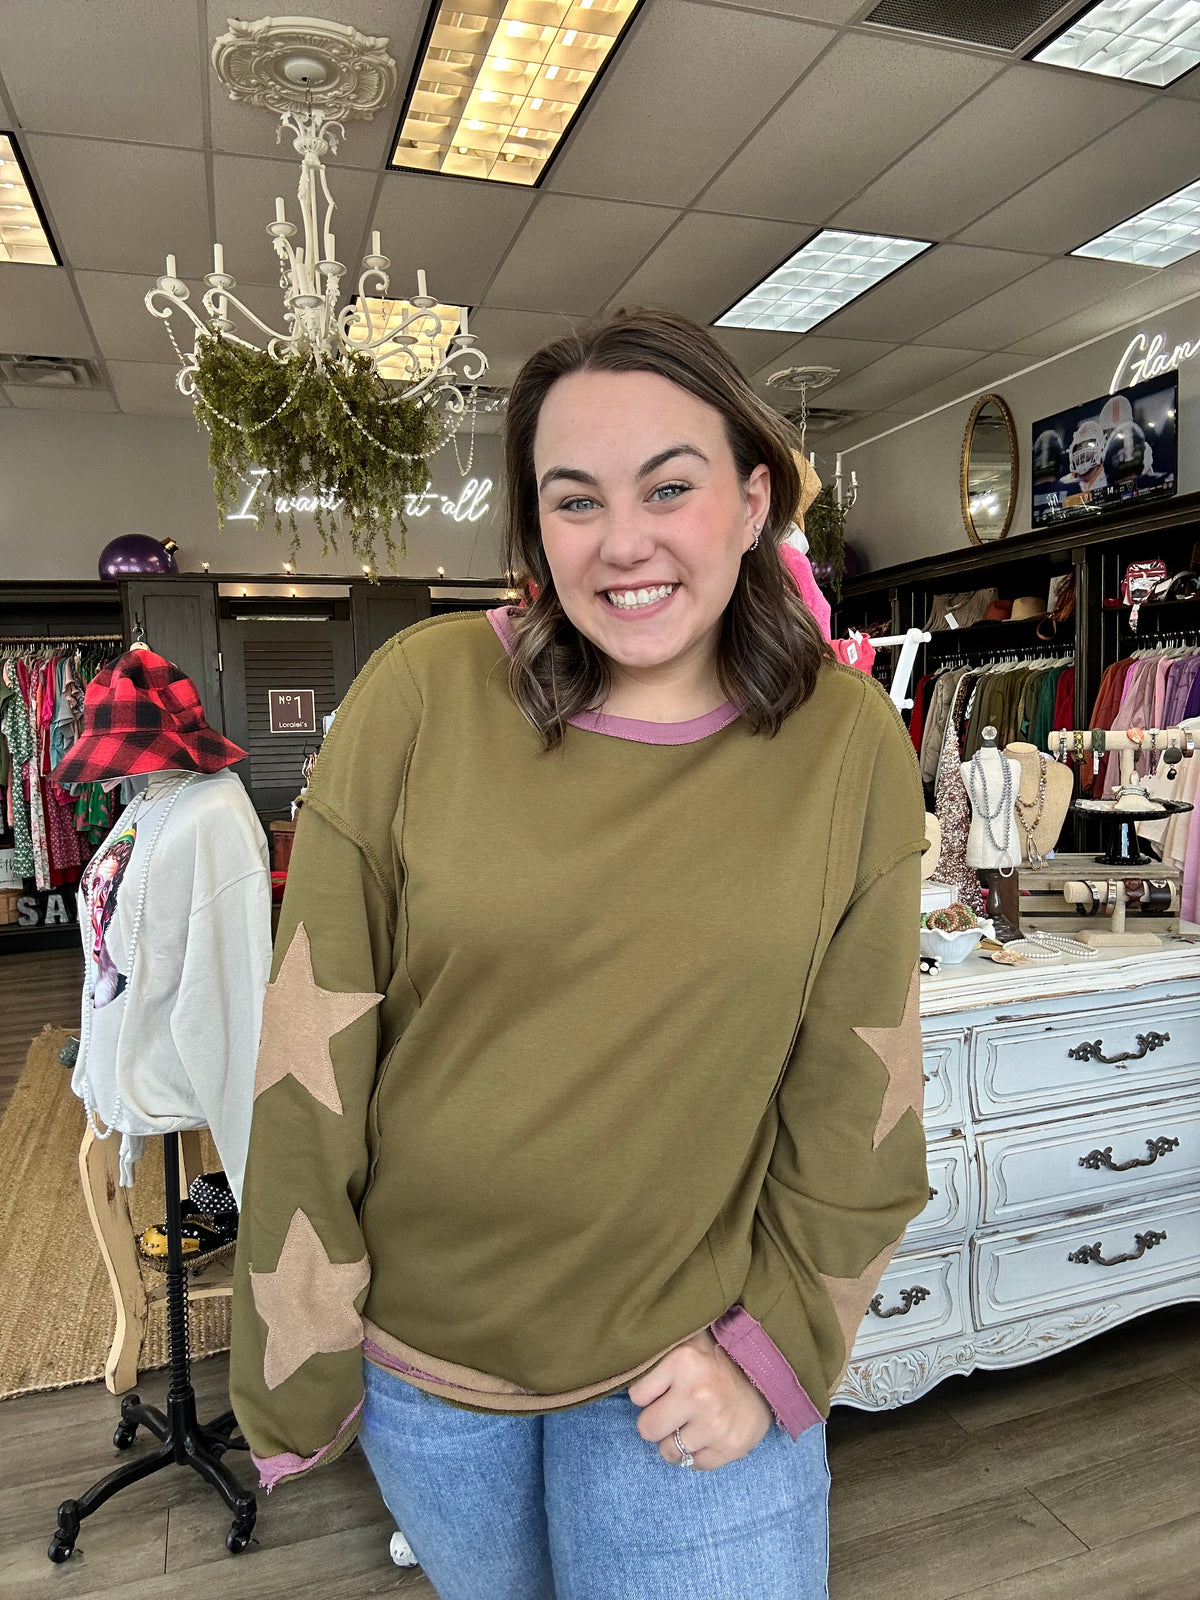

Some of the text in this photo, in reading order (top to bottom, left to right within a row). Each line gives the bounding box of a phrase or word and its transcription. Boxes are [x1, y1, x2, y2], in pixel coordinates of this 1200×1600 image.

[226, 468, 277, 521] I
[440, 478, 493, 522] all
[294, 696, 302, 718] 1
